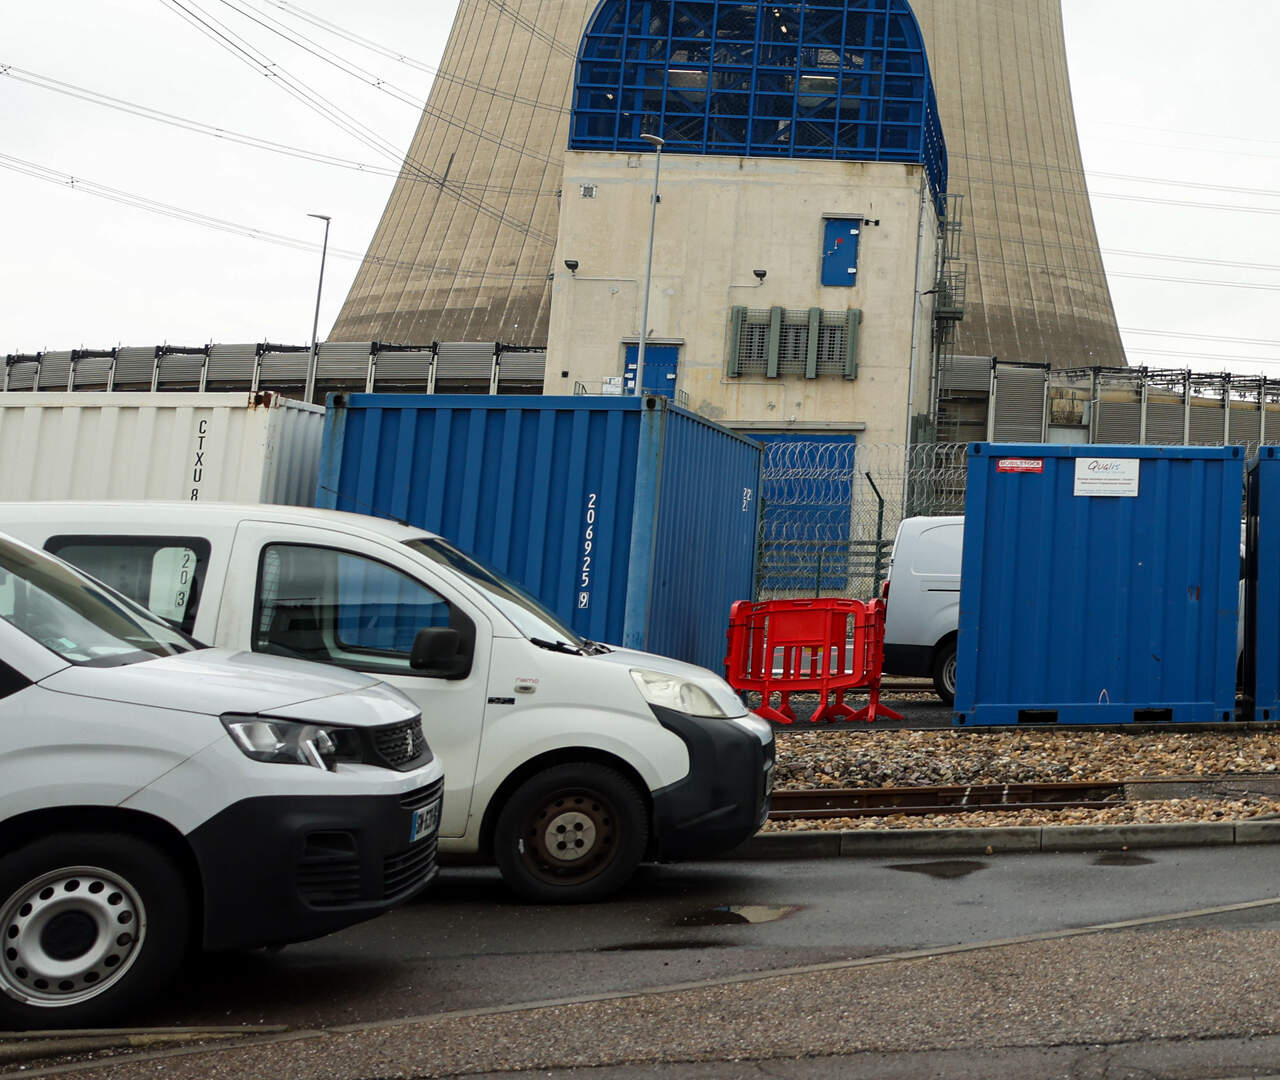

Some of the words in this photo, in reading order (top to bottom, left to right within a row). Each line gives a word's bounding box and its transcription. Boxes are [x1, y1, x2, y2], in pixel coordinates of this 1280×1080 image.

[193, 420, 207, 482] CTXU
[581, 493, 597, 587] 206925
[578, 592, 589, 608] 9
